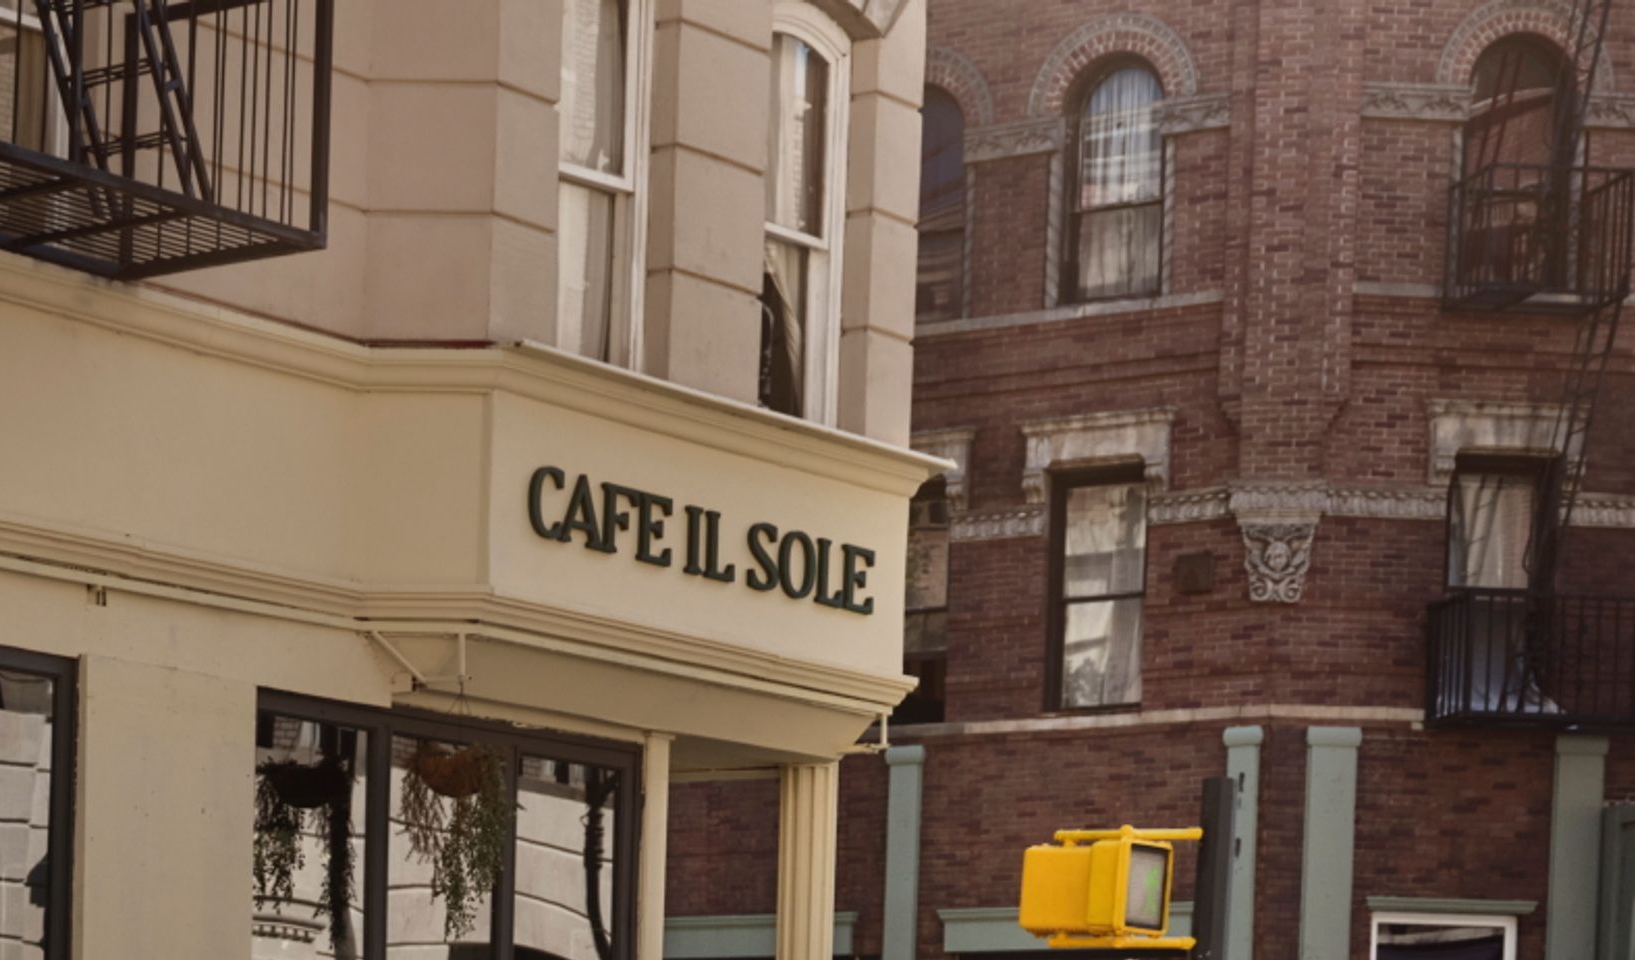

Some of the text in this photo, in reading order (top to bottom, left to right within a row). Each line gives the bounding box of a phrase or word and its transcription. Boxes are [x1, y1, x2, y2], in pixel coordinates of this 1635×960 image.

[528, 465, 875, 616] CAFE IL SOLE
